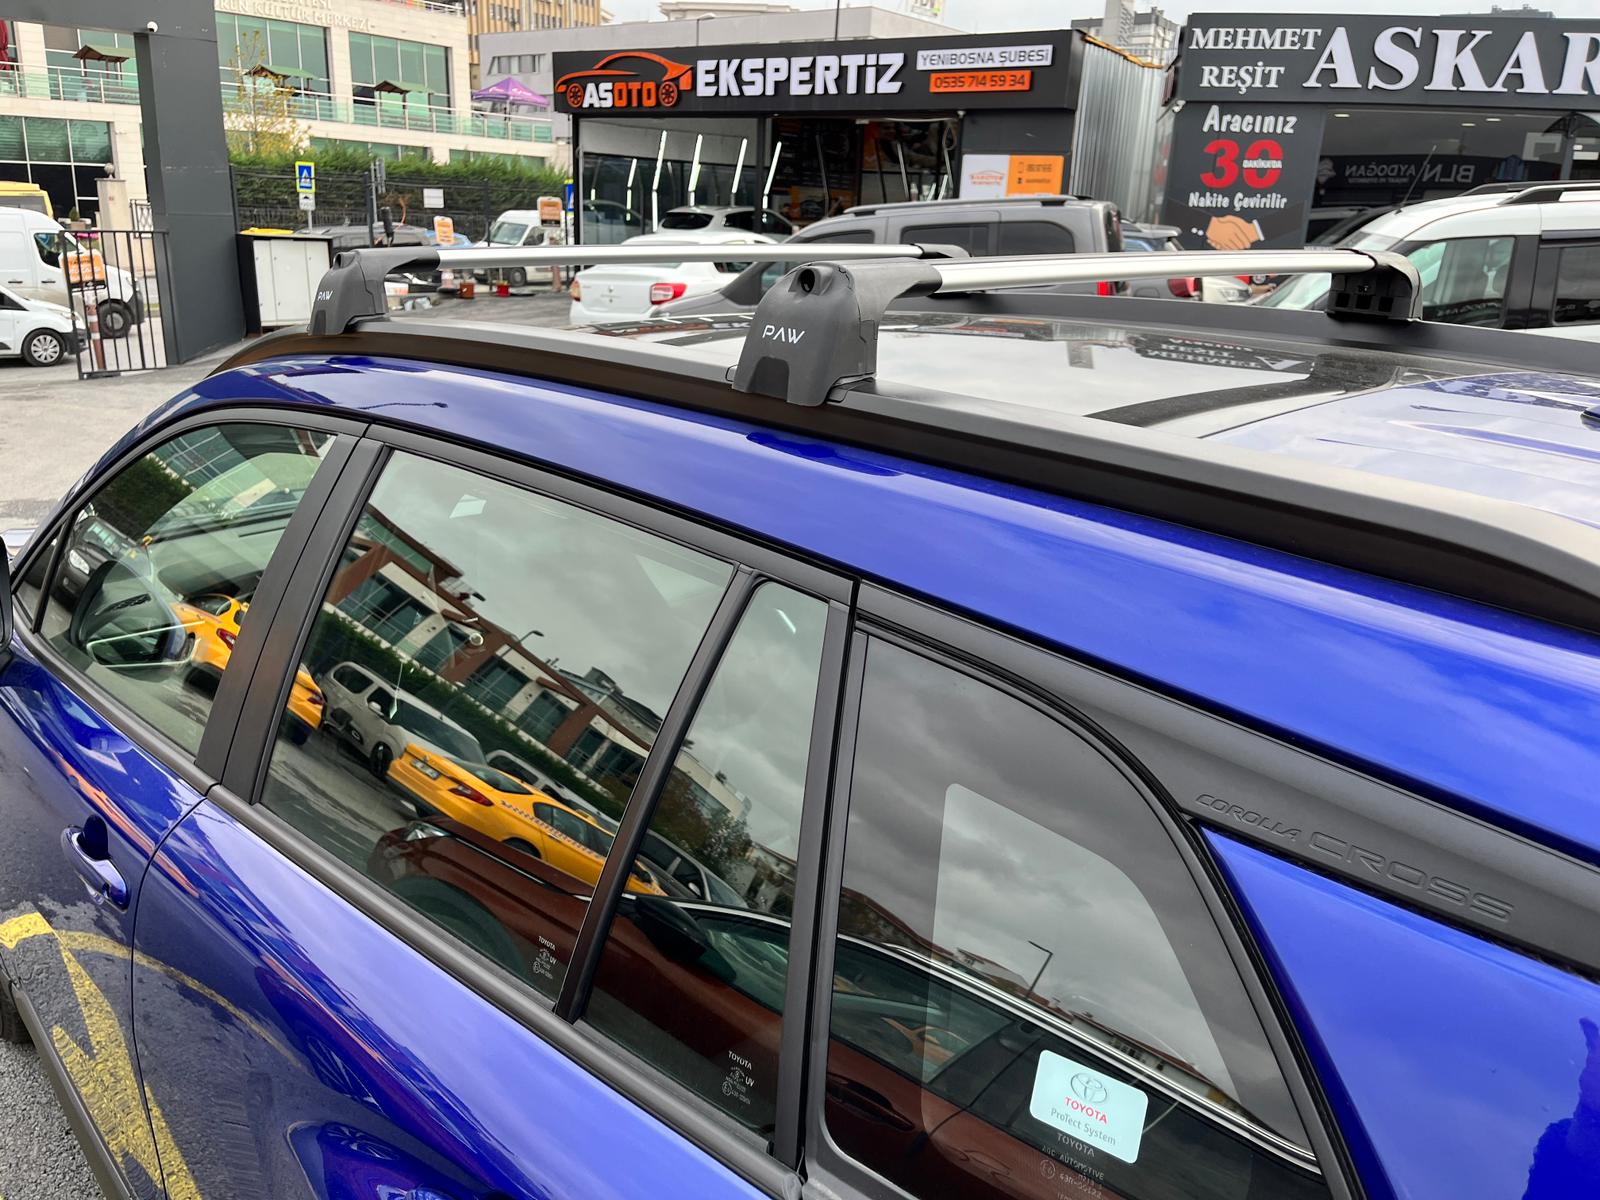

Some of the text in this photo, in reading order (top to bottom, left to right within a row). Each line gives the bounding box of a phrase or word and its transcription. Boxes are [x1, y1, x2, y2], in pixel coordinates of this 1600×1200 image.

[1188, 27, 1322, 50] MEHMET
[934, 74, 1026, 89] 0535 714 59 34
[1199, 61, 1286, 95] REŞİT
[581, 81, 657, 109] ASOTO
[1202, 104, 1298, 134] Aracınız
[1200, 138, 1284, 189] 30
[1188, 191, 1288, 212] Nakite Çevirilir
[317, 290, 334, 301] PAW
[762, 324, 806, 344] PAW
[1194, 793, 1516, 924] COROLLA CROSS
[538, 935, 556, 951] TOYOTA
[728, 1050, 752, 1071] TOYOTA
[745, 1076, 755, 1087] UV
[1064, 1096, 1109, 1125] TOYOTA
[1057, 1132, 1095, 1158] TOYOTA
[1083, 1121, 1117, 1147] System
